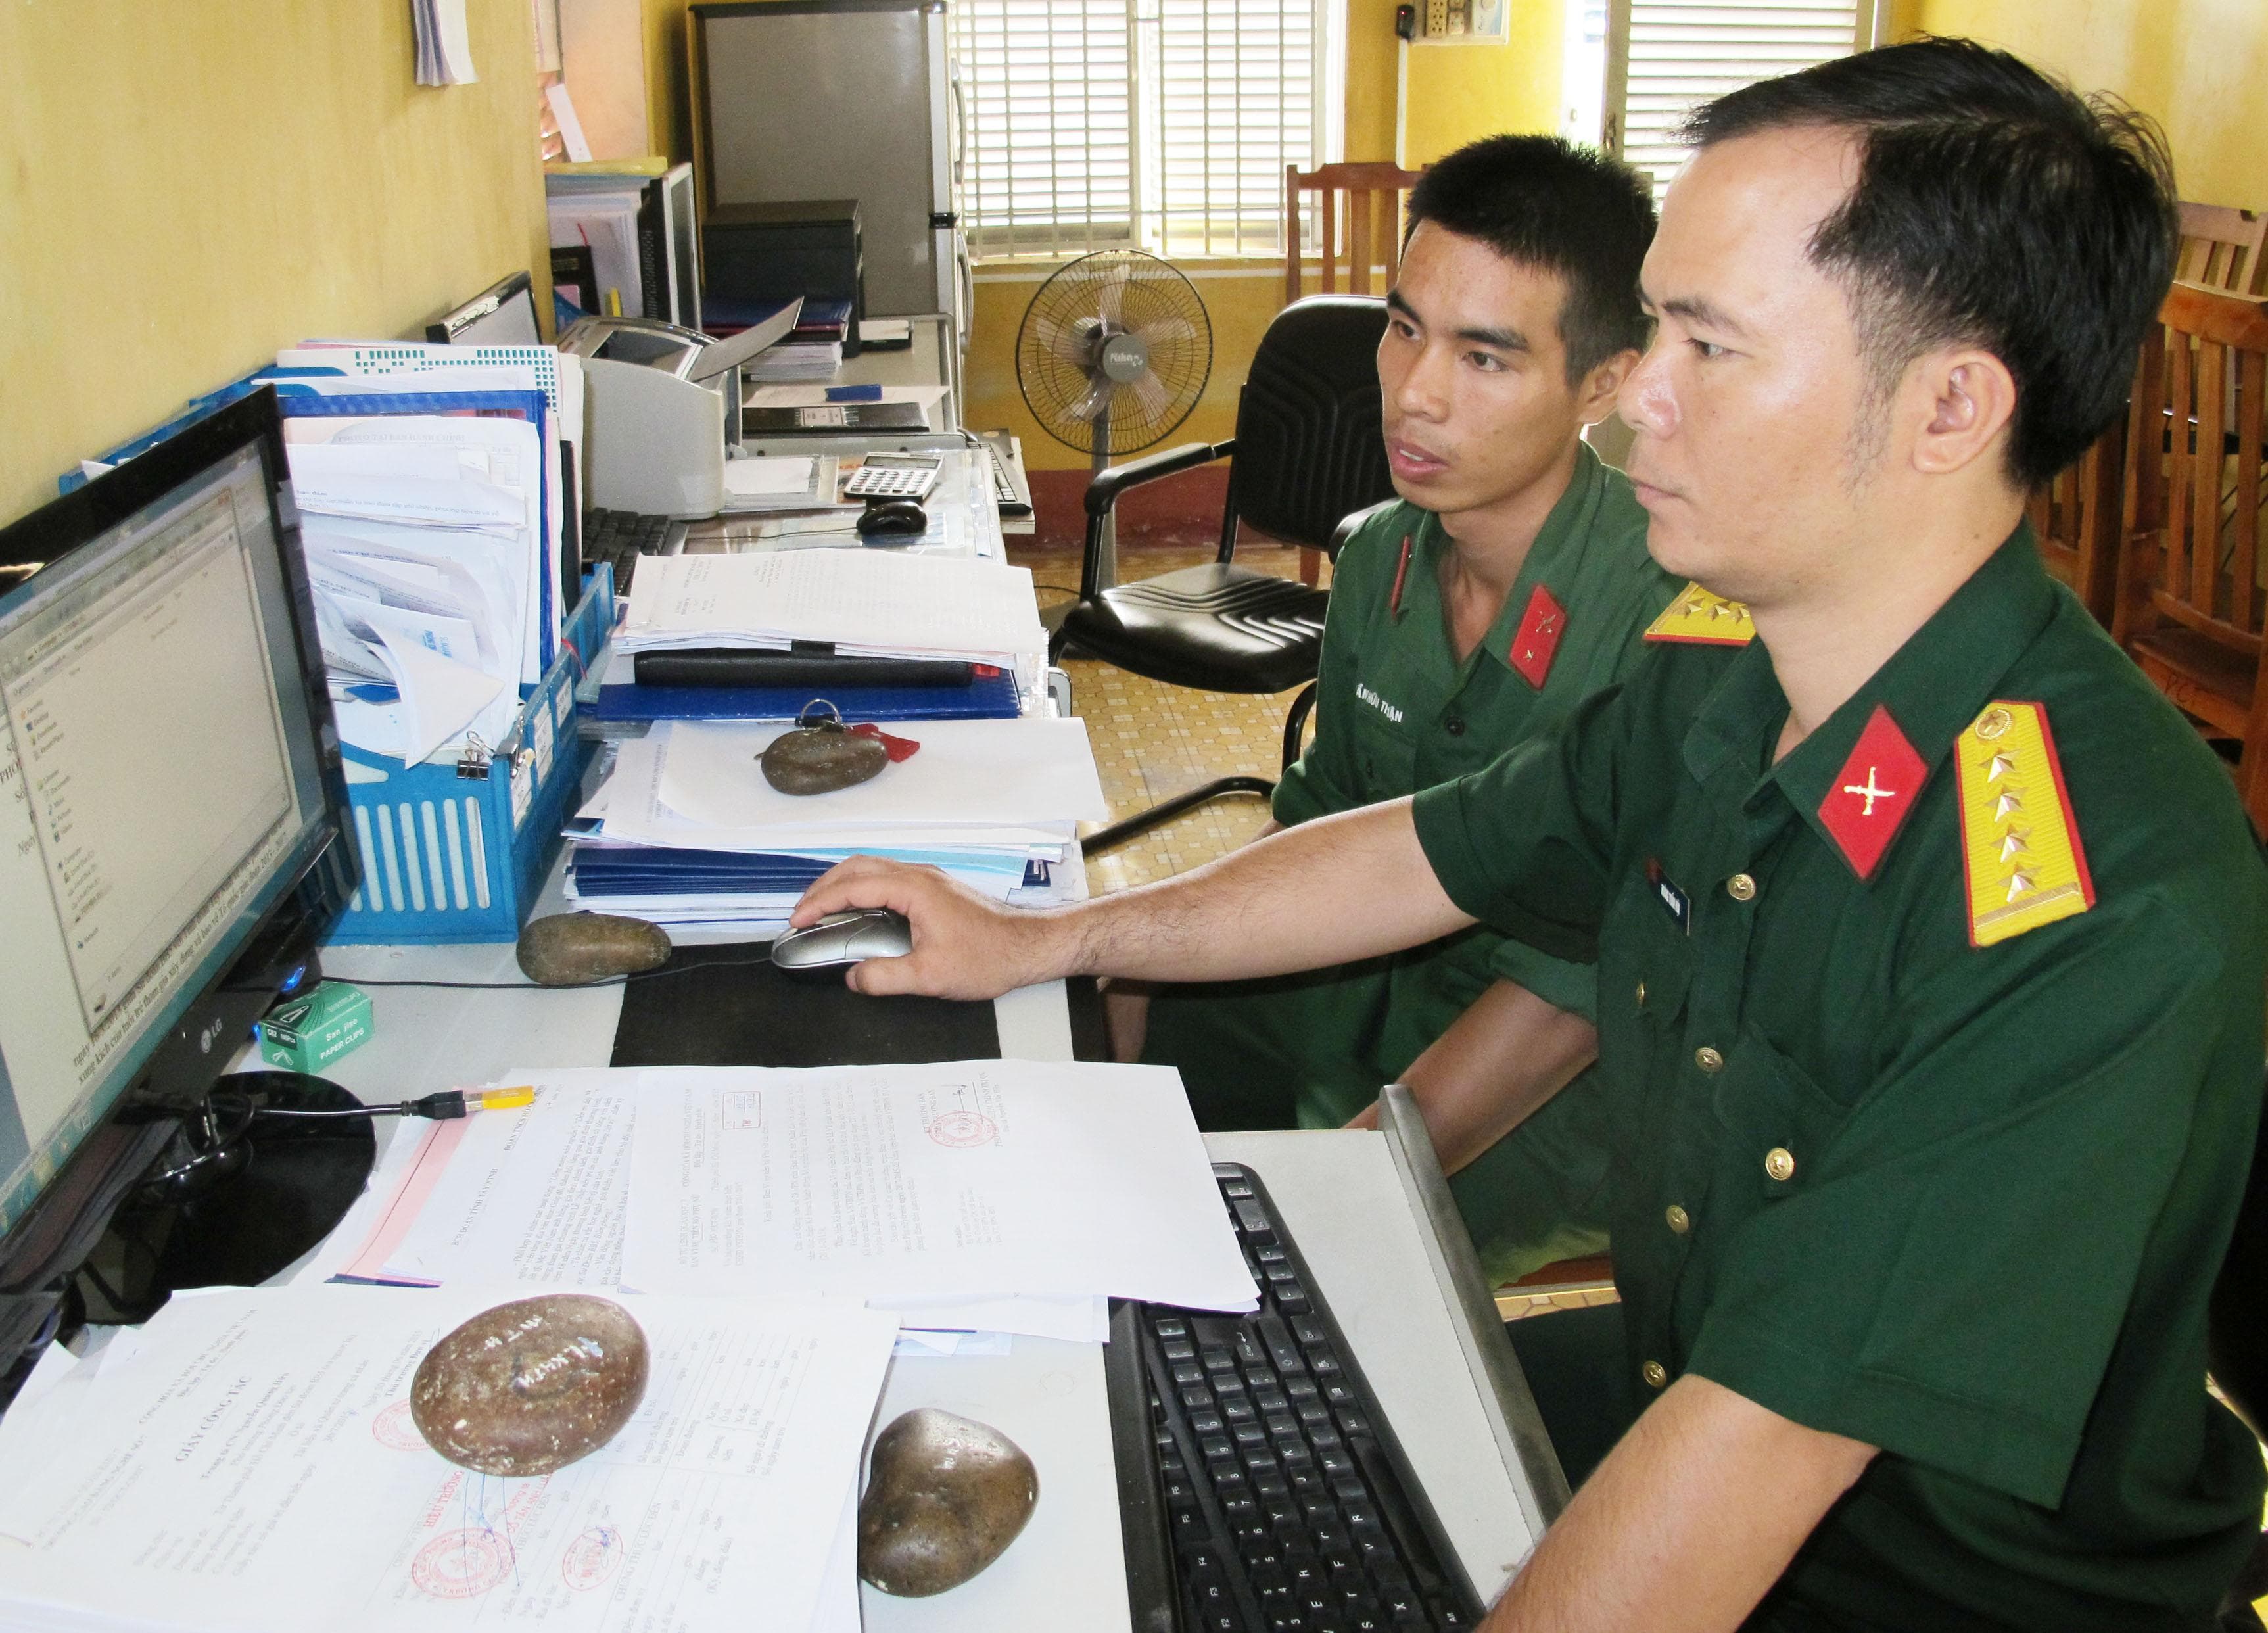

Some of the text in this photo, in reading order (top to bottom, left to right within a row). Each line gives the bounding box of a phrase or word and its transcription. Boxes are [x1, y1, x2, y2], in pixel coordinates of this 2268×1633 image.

[211, 1017, 222, 1037] LG
[326, 1029, 341, 1041] San
[320, 1028, 364, 1060] PAPER CLIPS
